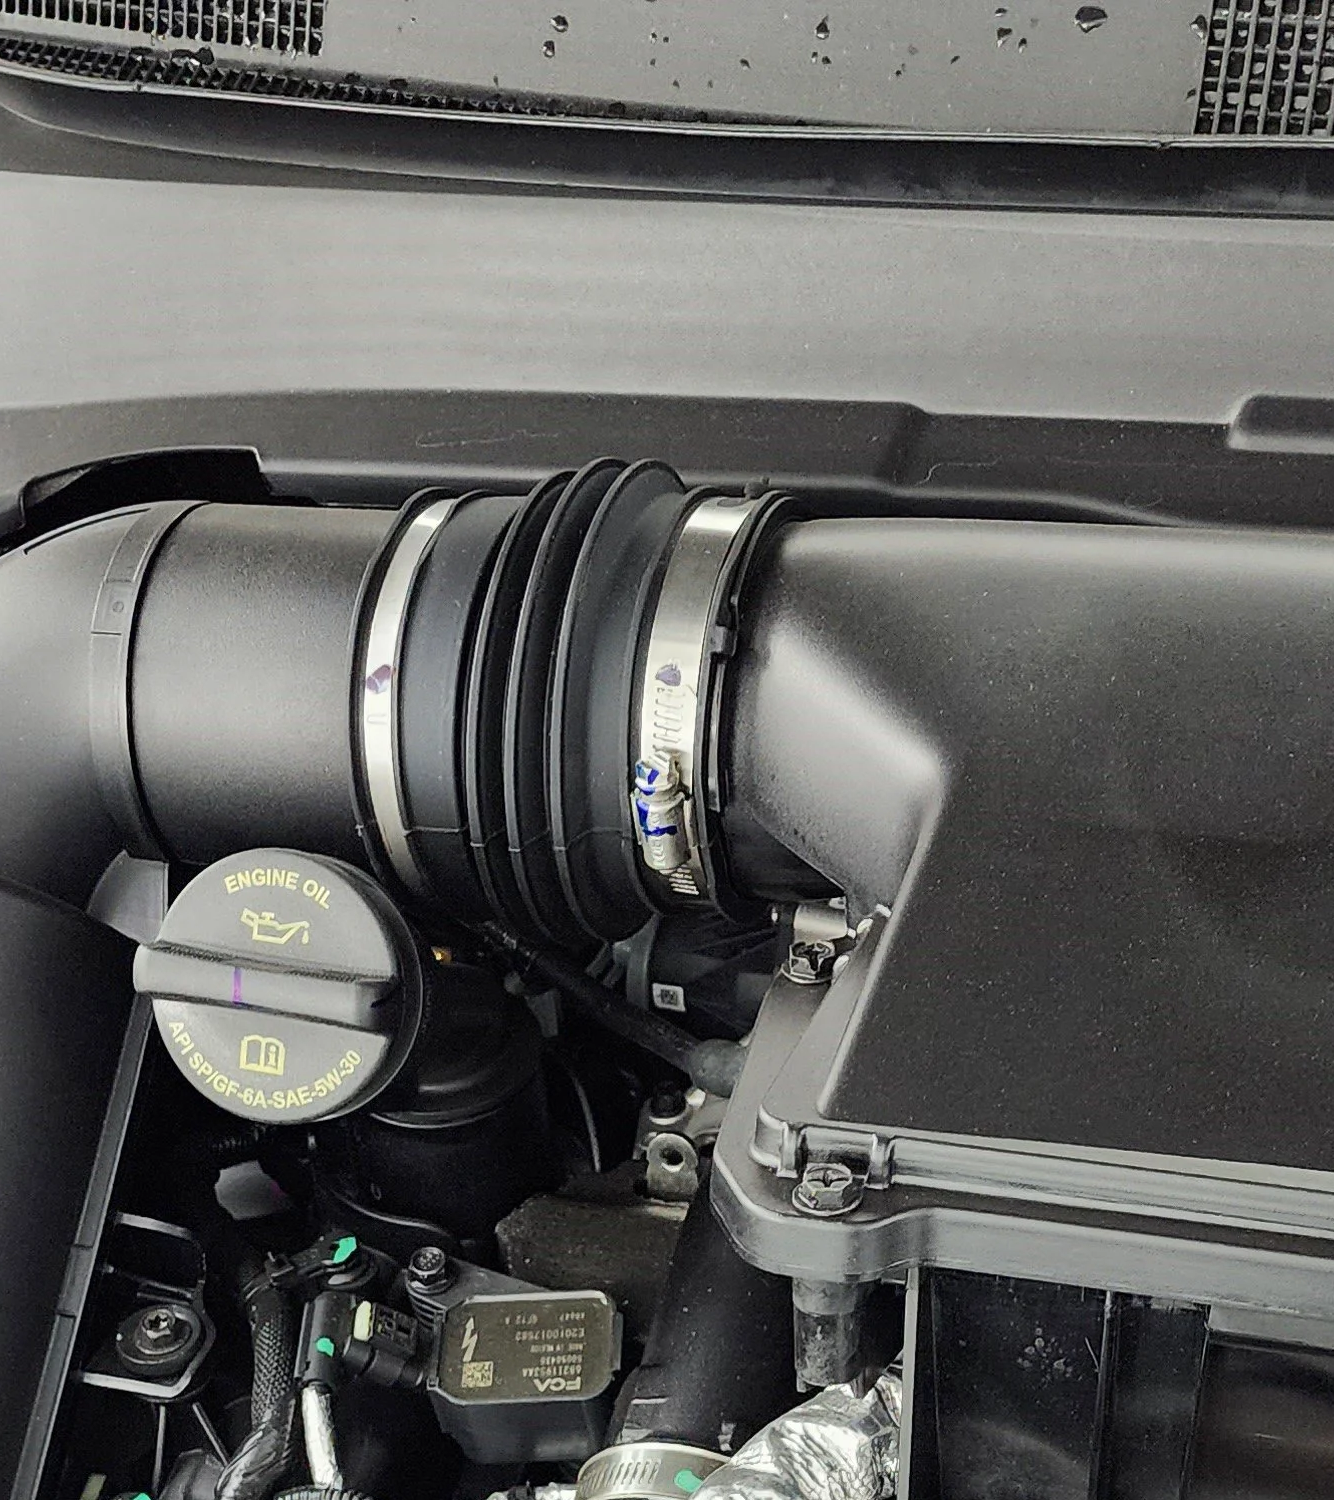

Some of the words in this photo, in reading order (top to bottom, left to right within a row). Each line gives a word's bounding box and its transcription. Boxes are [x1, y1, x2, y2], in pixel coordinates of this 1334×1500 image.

[223, 867, 300, 895] ENGINE
[302, 878, 333, 911] OIL
[169, 1020, 195, 1057] API
[188, 1049, 364, 1110] SP/GF-6A-SAE-5W-30
[533, 1376, 582, 1392] FCA
